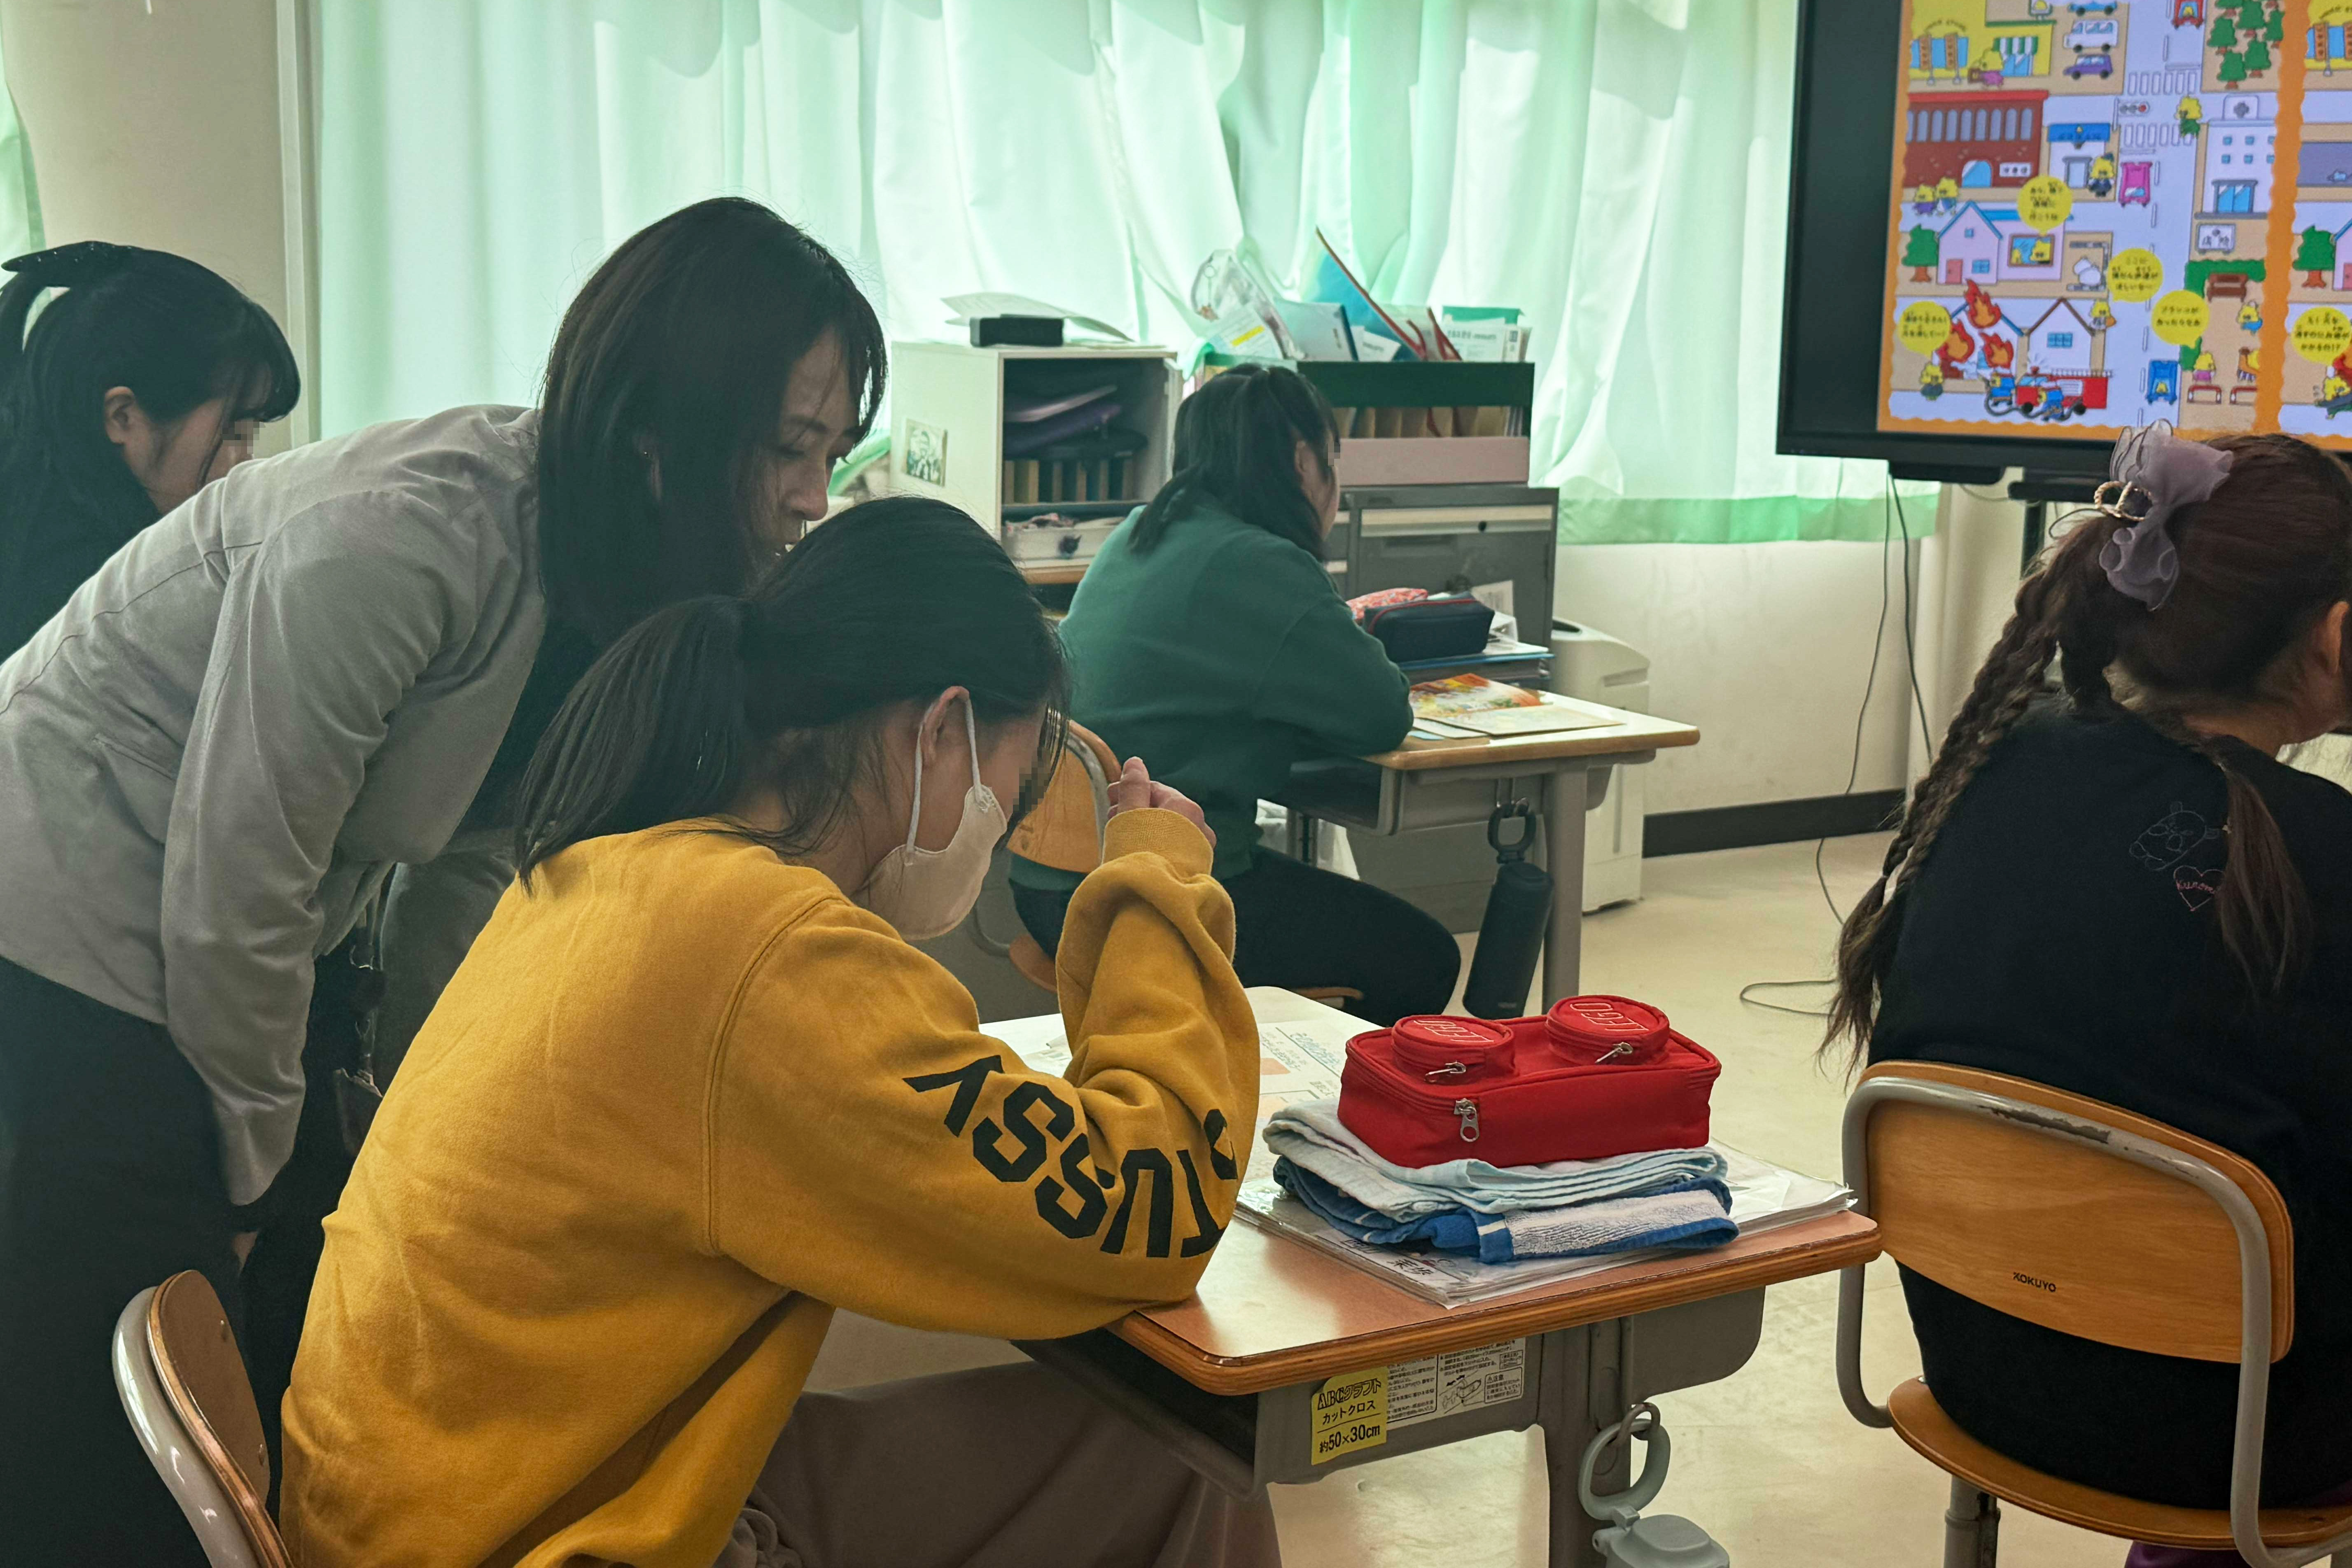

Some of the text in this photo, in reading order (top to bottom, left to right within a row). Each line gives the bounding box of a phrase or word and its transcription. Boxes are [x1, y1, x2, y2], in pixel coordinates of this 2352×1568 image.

[2013, 1272, 2056, 1292] KOKUYO
[1317, 1378, 1381, 1411] ABCクラフト
[1322, 1400, 1376, 1425] カットクロス
